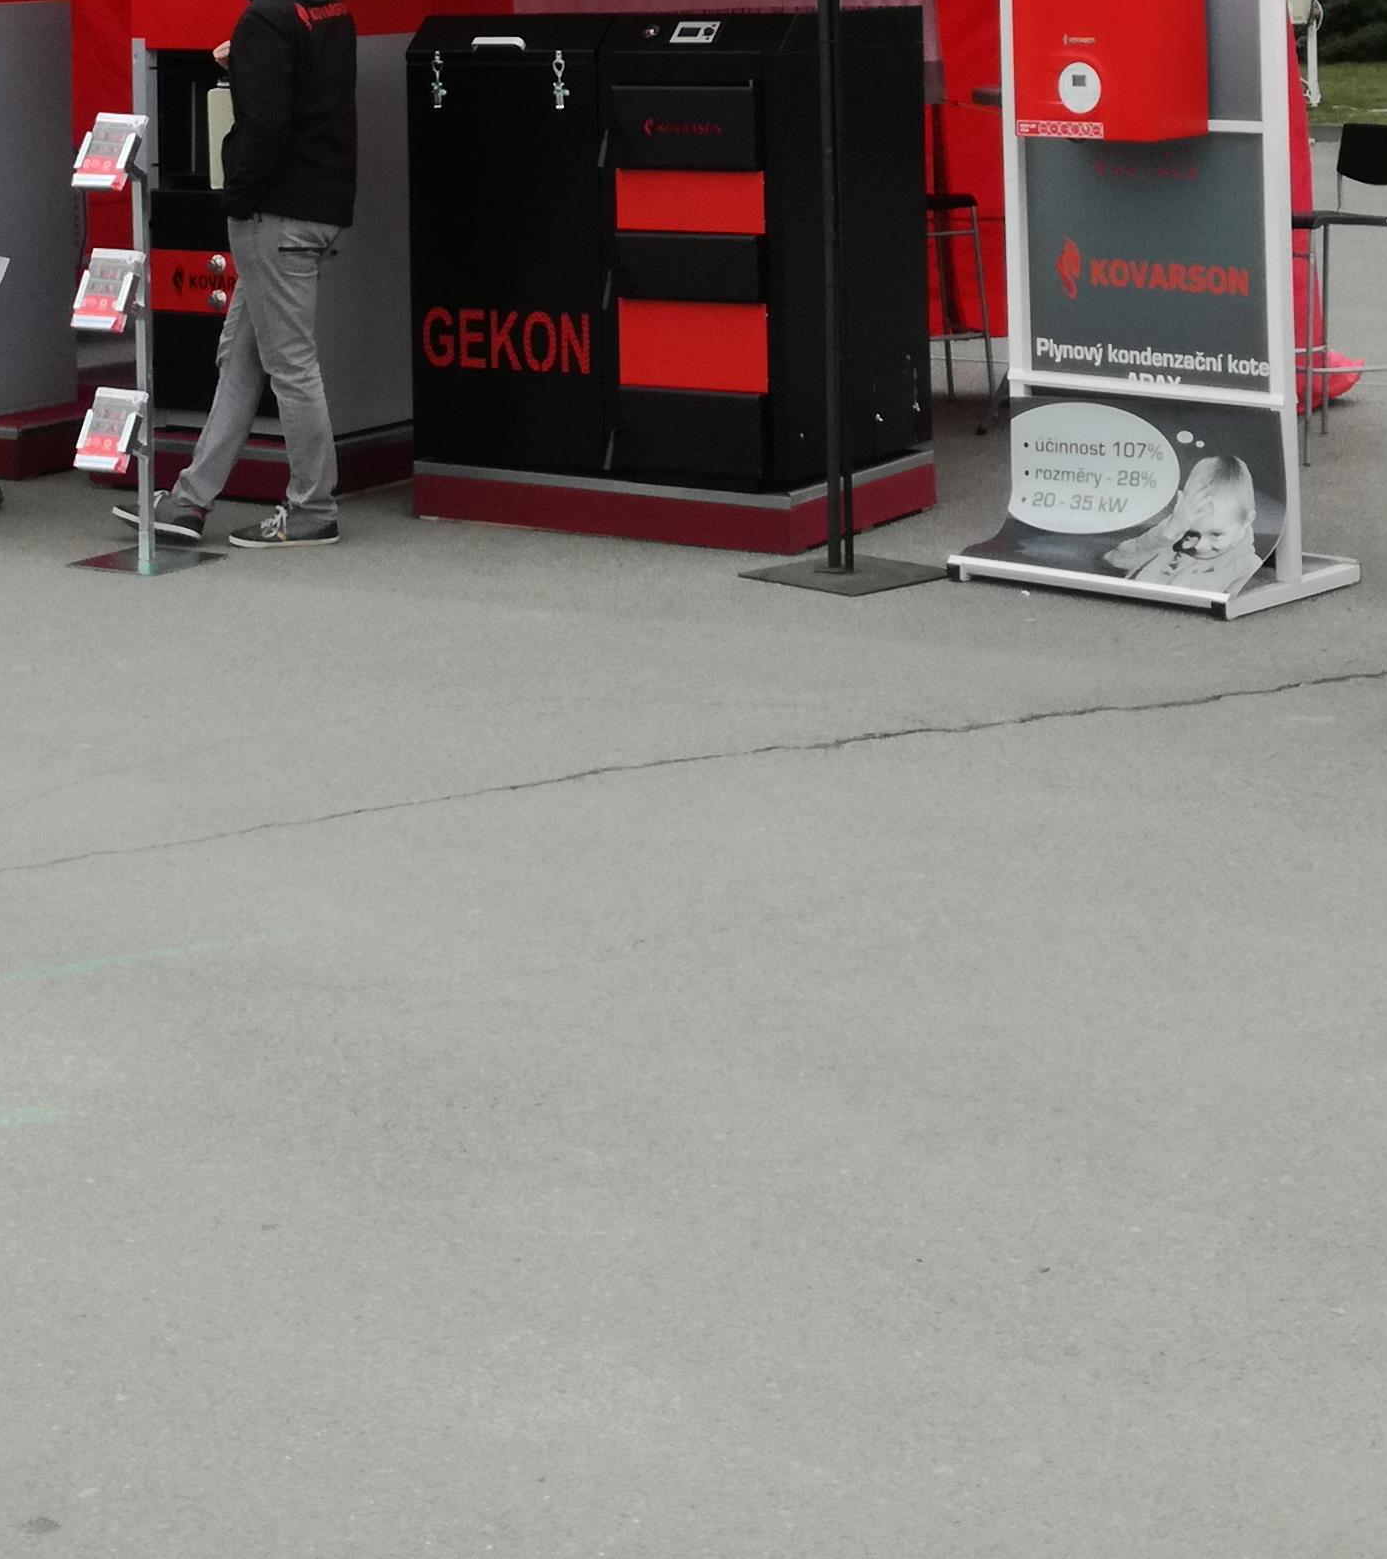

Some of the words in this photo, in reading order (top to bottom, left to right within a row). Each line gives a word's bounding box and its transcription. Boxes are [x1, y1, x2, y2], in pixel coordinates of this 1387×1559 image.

[1090, 258, 1251, 297] KOVARSON
[422, 307, 591, 375] GEKON
[1036, 337, 1104, 366] Plynový
[1107, 344, 1223, 373] kondenzační
[1034, 437, 1106, 457] účinnost
[1112, 441, 1164, 462] 107%
[1035, 467, 1102, 489] rozměry
[1116, 470, 1157, 489] 28%
[1032, 491, 1056, 508] 20
[1069, 494, 1093, 511] 35
[1098, 496, 1128, 514] kW
